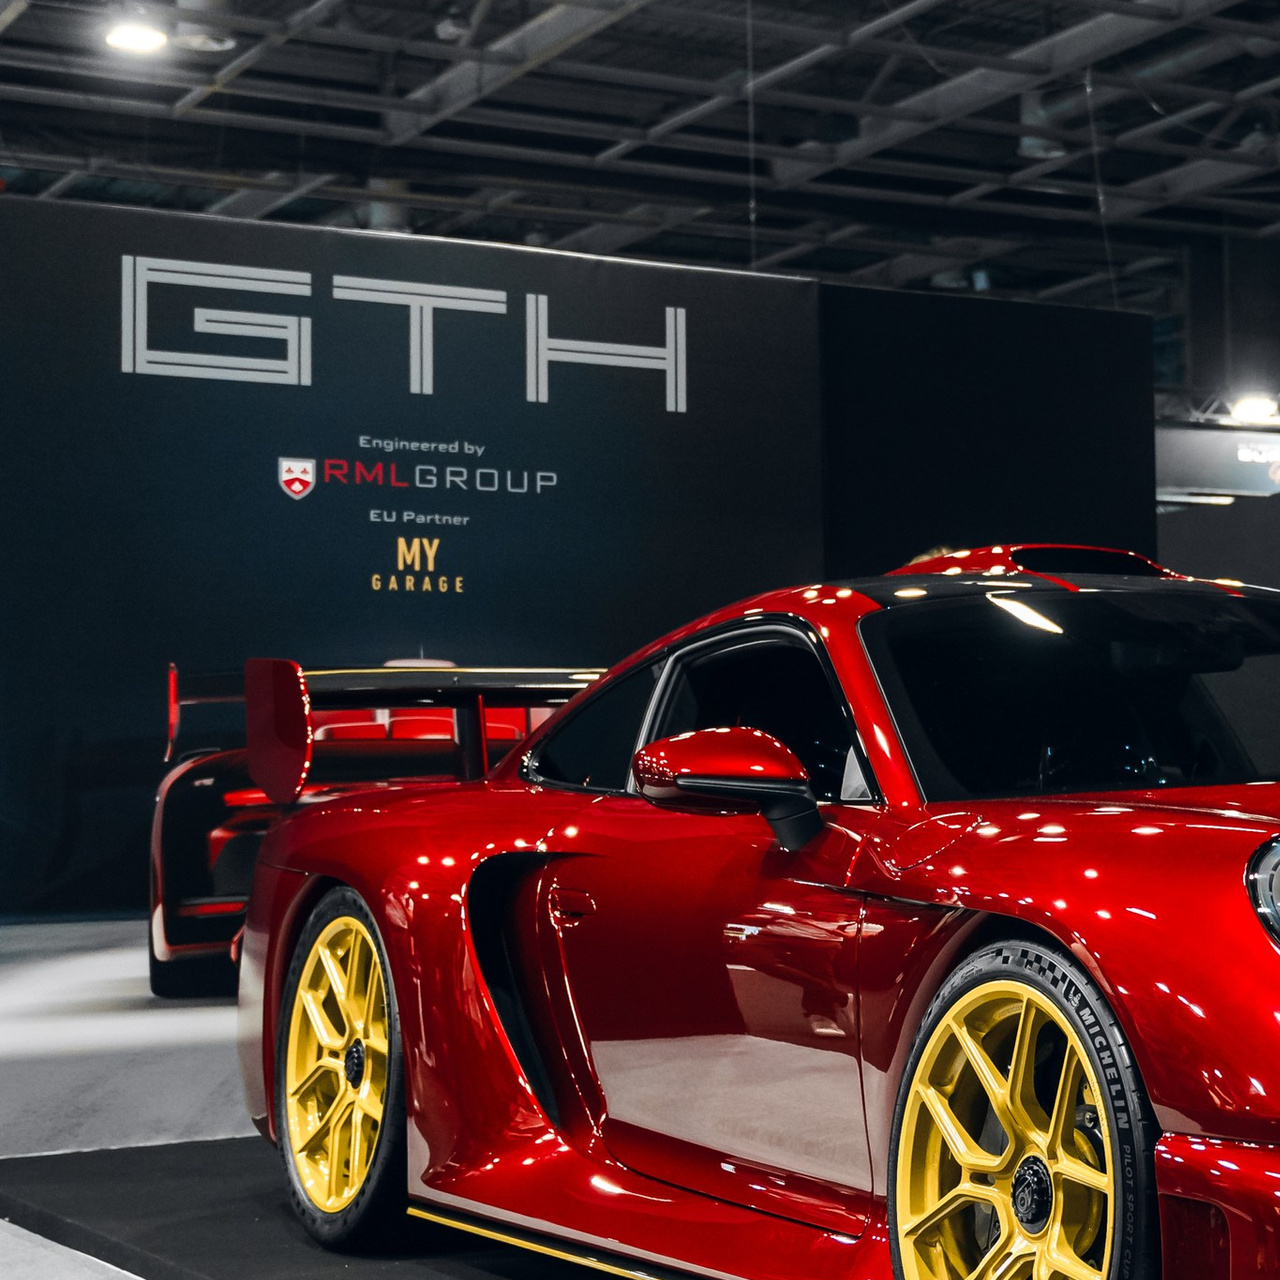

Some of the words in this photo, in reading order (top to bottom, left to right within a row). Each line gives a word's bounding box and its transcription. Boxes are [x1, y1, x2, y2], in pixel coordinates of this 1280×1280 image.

[121, 255, 687, 413] GTH
[359, 435, 459, 453] Engineered
[464, 441, 486, 457] by
[370, 510, 396, 523] EU
[403, 511, 470, 526] Partner
[397, 537, 440, 572] MY
[371, 574, 464, 593] GARAGE
[1079, 1006, 1131, 1129] MICHELIN
[1123, 1144, 1134, 1186] PILOT
[1125, 1192, 1135, 1245] SPORT
[1122, 1250, 1133, 1280] CUP
